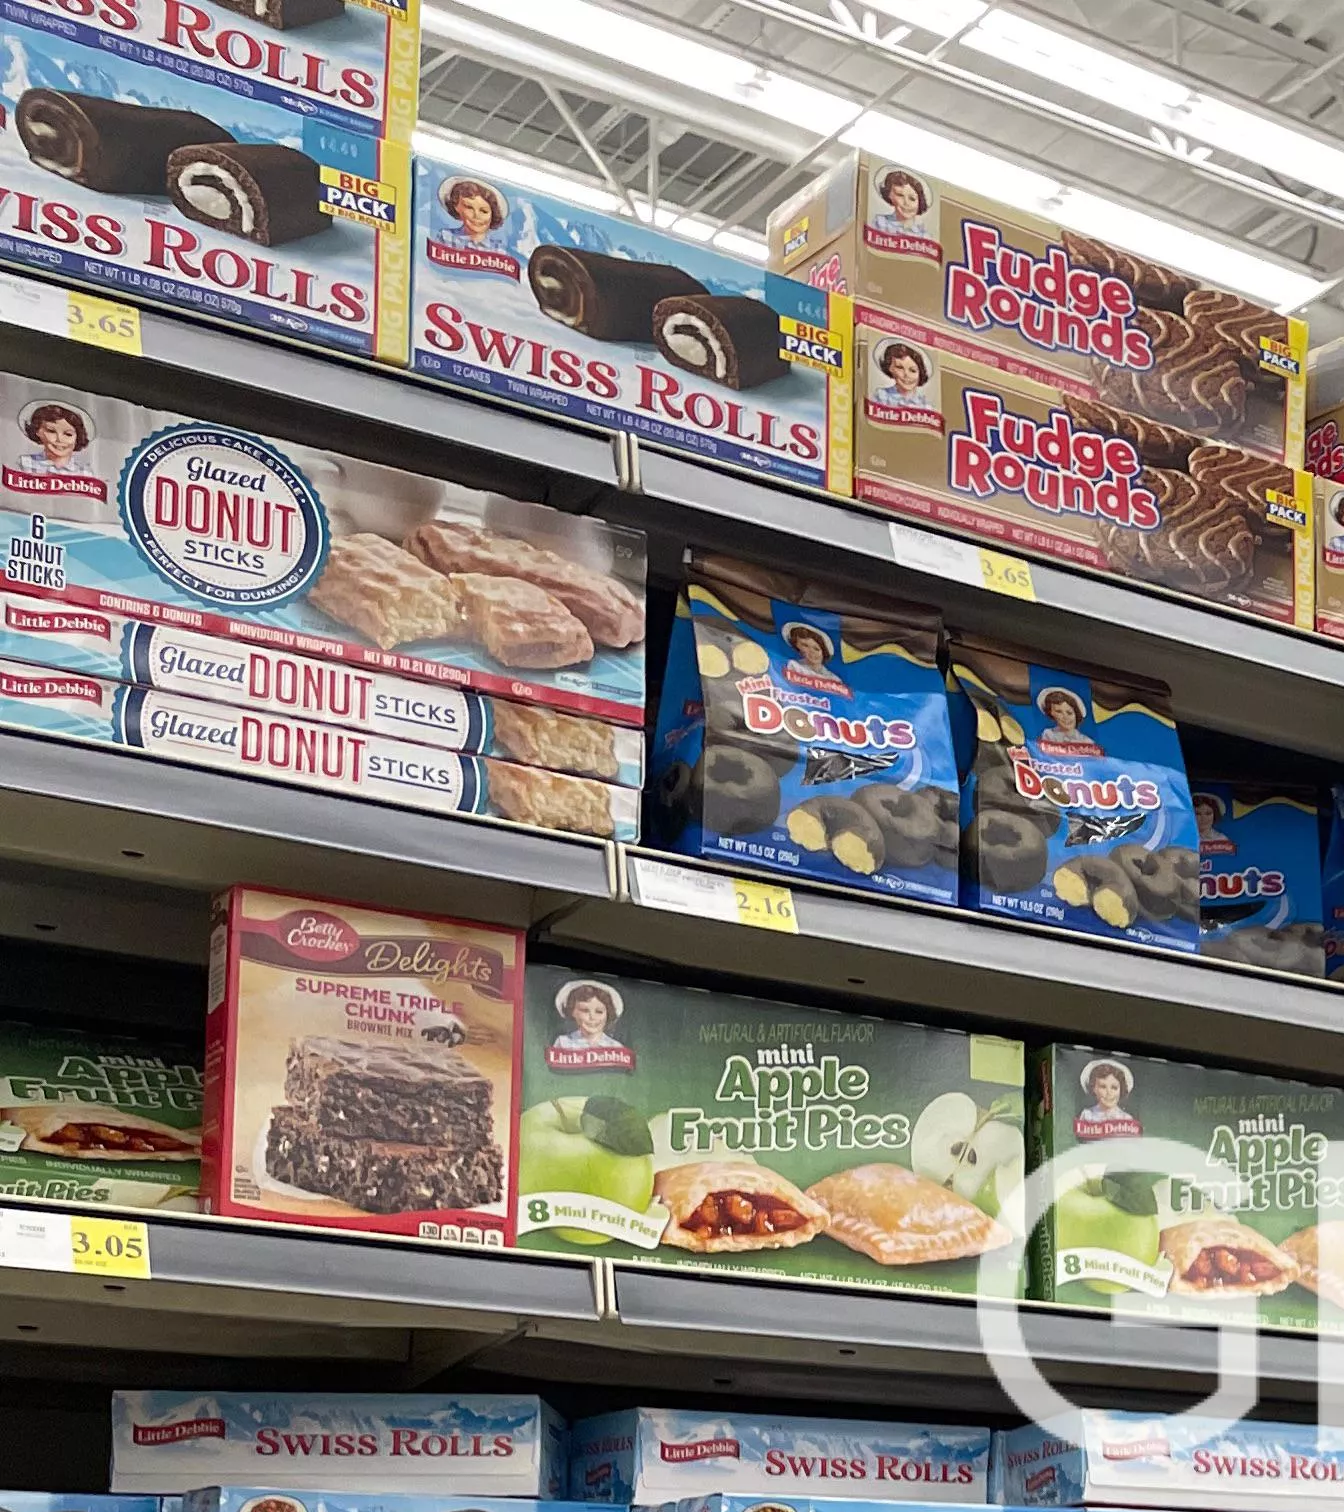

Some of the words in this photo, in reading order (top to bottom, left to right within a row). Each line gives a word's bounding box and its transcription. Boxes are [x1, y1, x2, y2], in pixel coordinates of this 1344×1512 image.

[340, 173, 379, 196] BIG
[326, 189, 388, 220] PACK
[144, 217, 367, 324] ROLLS
[431, 246, 466, 267] Little
[468, 252, 517, 274] Debbie
[961, 219, 1136, 317] Fudge
[68, 302, 136, 338] 3.65
[946, 262, 1155, 370] Rounds
[795, 322, 829, 344] BIG
[784, 337, 838, 366] PACK
[1262, 352, 1300, 373] PACK
[424, 301, 620, 400] SWISS
[634, 364, 821, 462] ROLLS
[962, 389, 1141, 479] Fudge
[5, 474, 47, 494] Little
[50, 477, 103, 498] Debbie
[186, 455, 267, 493] Glazed
[947, 431, 1161, 530] Rounds
[31, 515, 46, 541] 6
[154, 476, 298, 554] DONUT
[1268, 502, 1307, 525] PACK
[9, 534, 64, 565] DONUT
[183, 538, 266, 571] STICKS
[6, 559, 65, 591] STICKS
[204, 584, 239, 601] FOR
[10, 607, 51, 628] Little
[53, 613, 106, 633] Debbie
[44, 680, 98, 700] Debbie
[158, 645, 245, 686] Glazed
[248, 650, 373, 722] DONUT
[375, 692, 457, 725] STICKS
[736, 672, 772, 695] Mini
[772, 686, 831, 711] Frosted
[742, 695, 918, 750] Donuts
[150, 708, 237, 750] Glazed
[240, 715, 366, 784] DONUT
[368, 755, 451, 787] STICKS
[1014, 759, 1161, 812] Donuts
[735, 890, 792, 921] 2.16
[287, 929, 352, 954] Crocker
[300, 917, 344, 942] Betty
[364, 942, 493, 983] Delights
[295, 976, 391, 1005] SUPREME
[396, 991, 464, 1015] TRIPLE
[345, 1002, 415, 1025] CHUNK
[346, 1019, 392, 1037] BROWNIE
[395, 1024, 413, 1039] MIX
[699, 1024, 755, 1044] NATURAL
[767, 1024, 831, 1043] ARTIFICIAL
[831, 1023, 876, 1044] FLAVOR
[757, 1043, 814, 1066] mini
[717, 1055, 870, 1112] Apple
[668, 1108, 798, 1154] Fruit
[802, 1104, 911, 1152] Pies
[1239, 1114, 1286, 1133] mini
[1207, 1125, 1329, 1174] Apple
[527, 1200, 549, 1222] 8
[554, 1205, 587, 1221] Mini
[591, 1208, 628, 1230] Fruit
[72, 1231, 143, 1260] 3.05
[255, 1427, 379, 1459] SWISS
